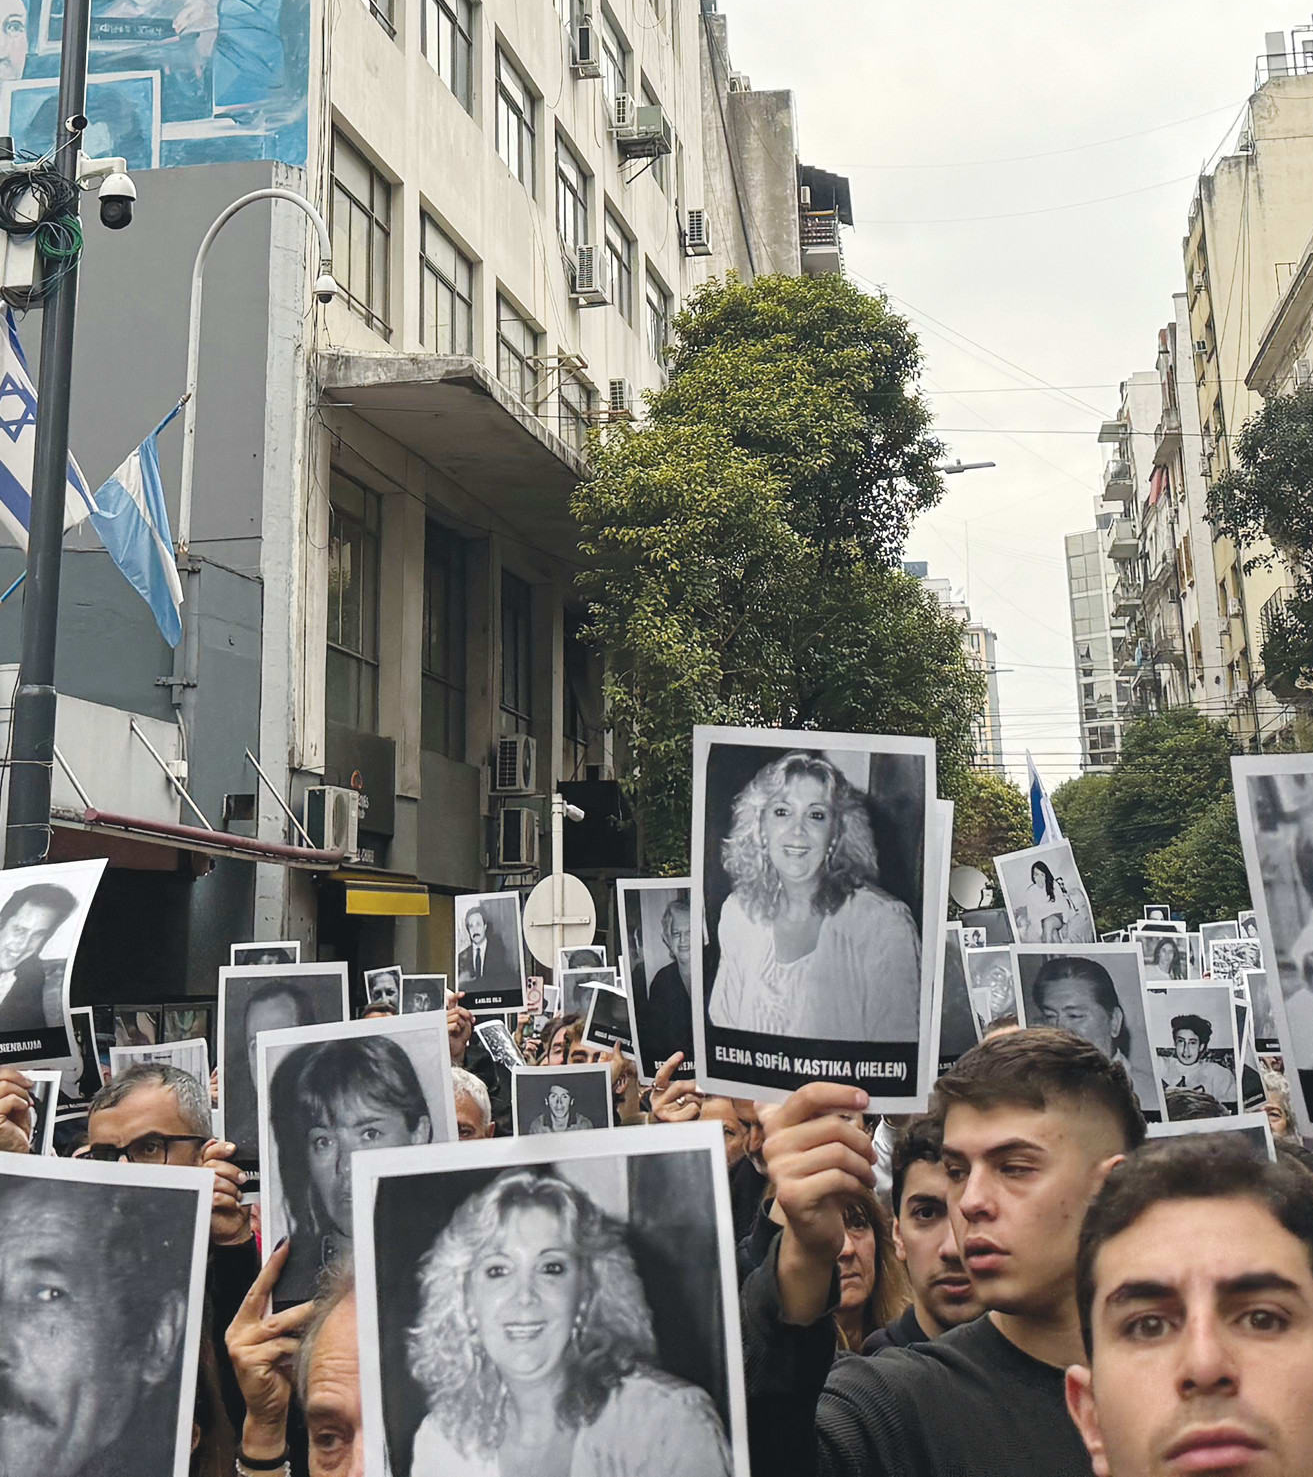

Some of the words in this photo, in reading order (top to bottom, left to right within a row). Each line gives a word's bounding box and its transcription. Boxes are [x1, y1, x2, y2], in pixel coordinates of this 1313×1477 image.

[715, 1045, 752, 1066] ELENA
[755, 1051, 791, 1072] SOFÍA
[794, 1057, 852, 1077] KASTIKA
[855, 1061, 907, 1081] (HELEN)
